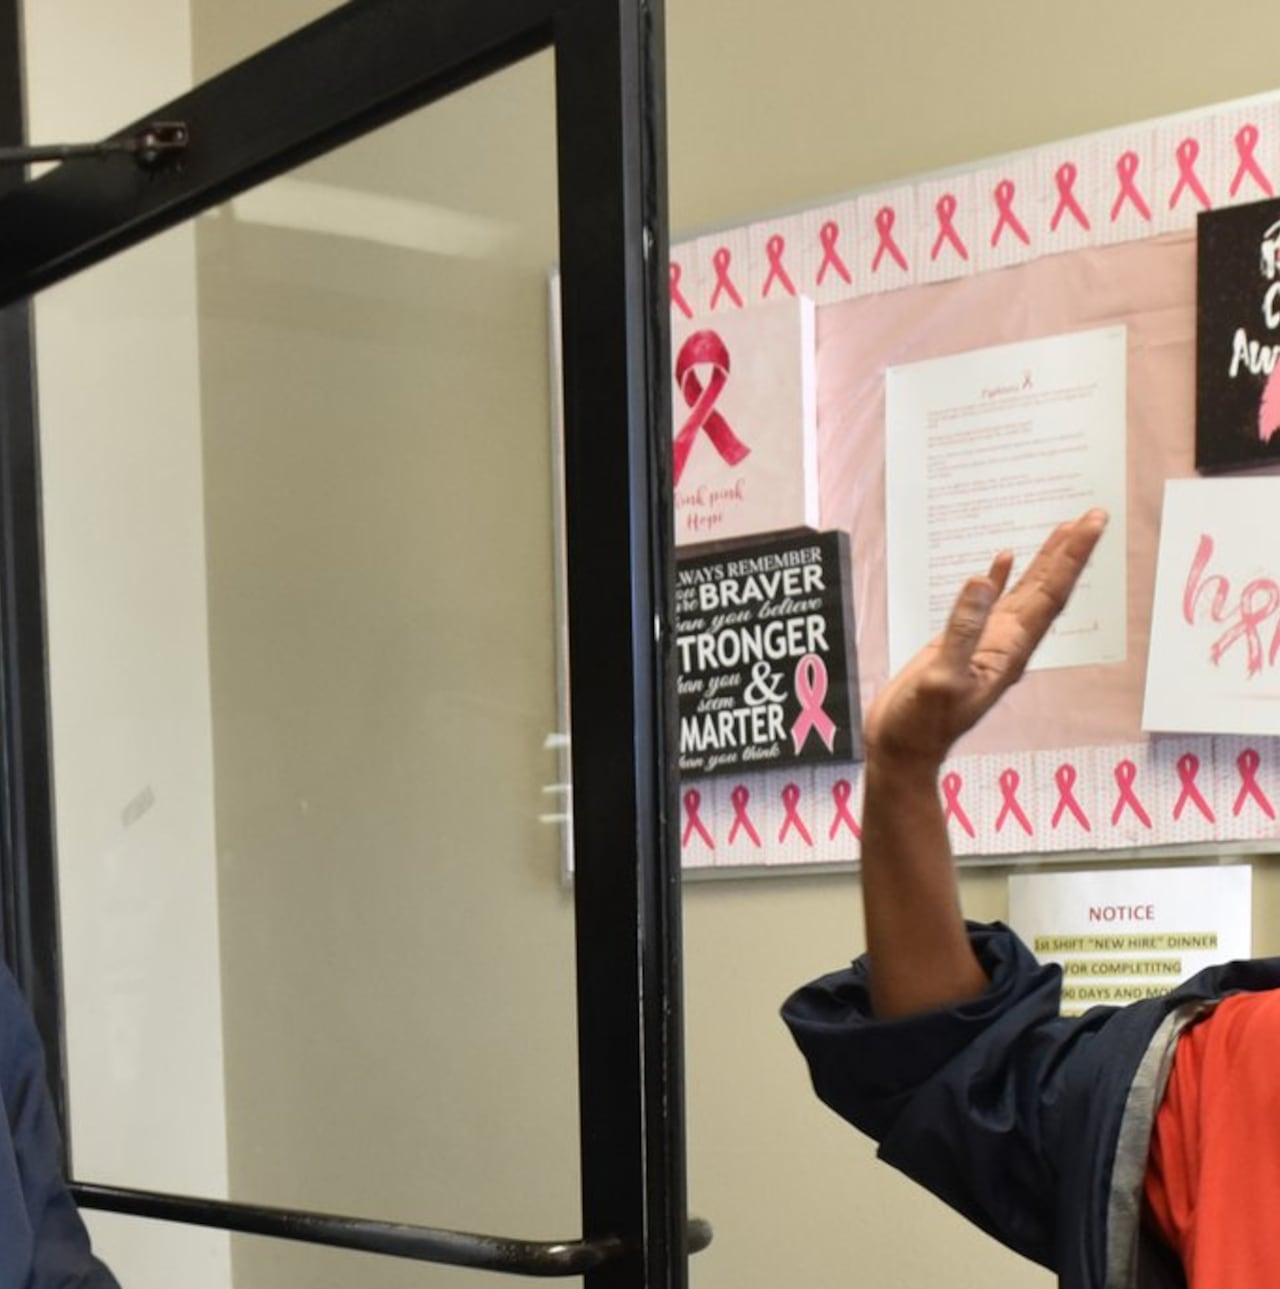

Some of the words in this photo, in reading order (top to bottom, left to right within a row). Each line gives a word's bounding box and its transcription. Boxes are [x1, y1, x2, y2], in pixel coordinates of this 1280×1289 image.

[676, 565, 724, 587] WAYS
[727, 547, 823, 577] REMEMBER
[699, 564, 825, 611] BRAVER
[706, 609, 753, 634] you
[758, 597, 823, 619] believe
[676, 614, 829, 673] TRONGER
[677, 675, 703, 694] han
[704, 674, 742, 697] you
[743, 660, 788, 706] &
[697, 696, 736, 713] seem
[680, 703, 788, 754] MARTER
[704, 751, 738, 772] you
[742, 743, 782, 761] think
[1089, 905, 1156, 922] NOTICE
[1053, 937, 1084, 951] SHIFT
[1168, 934, 1218, 948] DINNER
[1078, 987, 1111, 999] DAYS
[1113, 986, 1142, 999] AND
